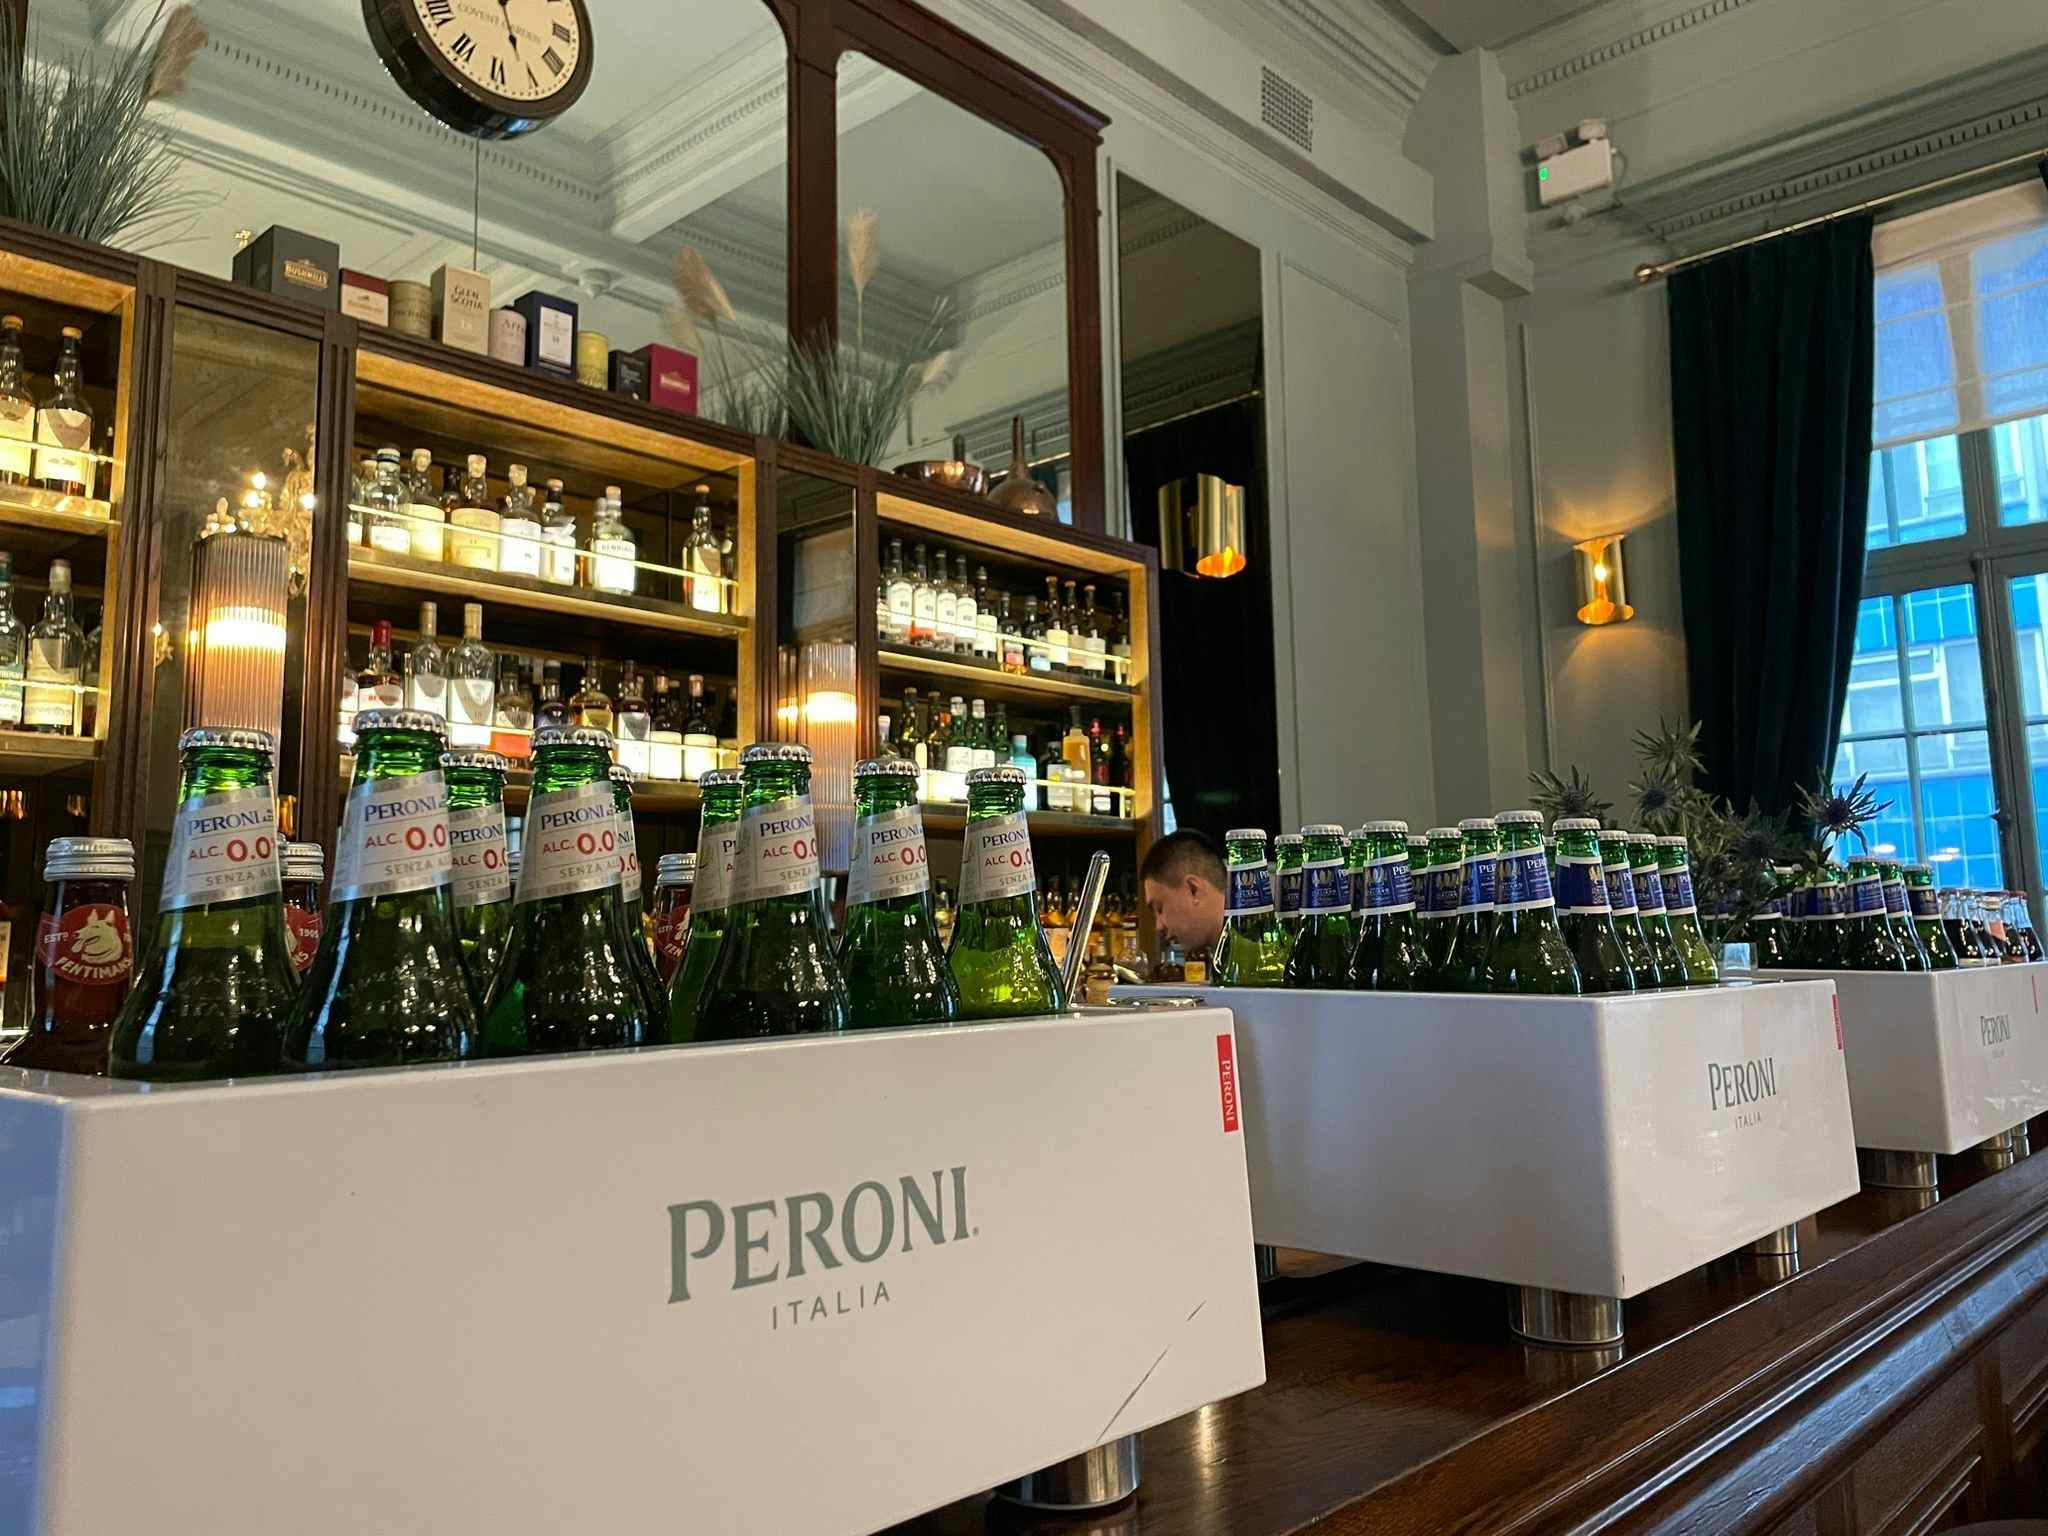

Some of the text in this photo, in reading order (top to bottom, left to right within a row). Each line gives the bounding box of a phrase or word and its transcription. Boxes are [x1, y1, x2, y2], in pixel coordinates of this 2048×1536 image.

[364, 795, 438, 822] PERONI
[541, 804, 605, 830] PERONI
[187, 809, 260, 836] PERONI
[364, 832, 402, 849] ALC.
[450, 823, 504, 846] PERON
[188, 845, 224, 861] ALC.
[543, 839, 575, 855] ALC.
[763, 846, 792, 858] ALC.
[384, 859, 433, 876] SENZA
[873, 852, 899, 866] ALC.
[984, 855, 1008, 867] ALC.
[560, 862, 603, 878] SENZA
[207, 871, 256, 887] SENZA
[1222, 1060, 1235, 1121] PERONI
[1707, 1057, 1777, 1111] PERONI
[1735, 1111, 1762, 1129] ITALIA
[666, 1165, 969, 1305] PERONI
[771, 1280, 891, 1330] ITALIA
